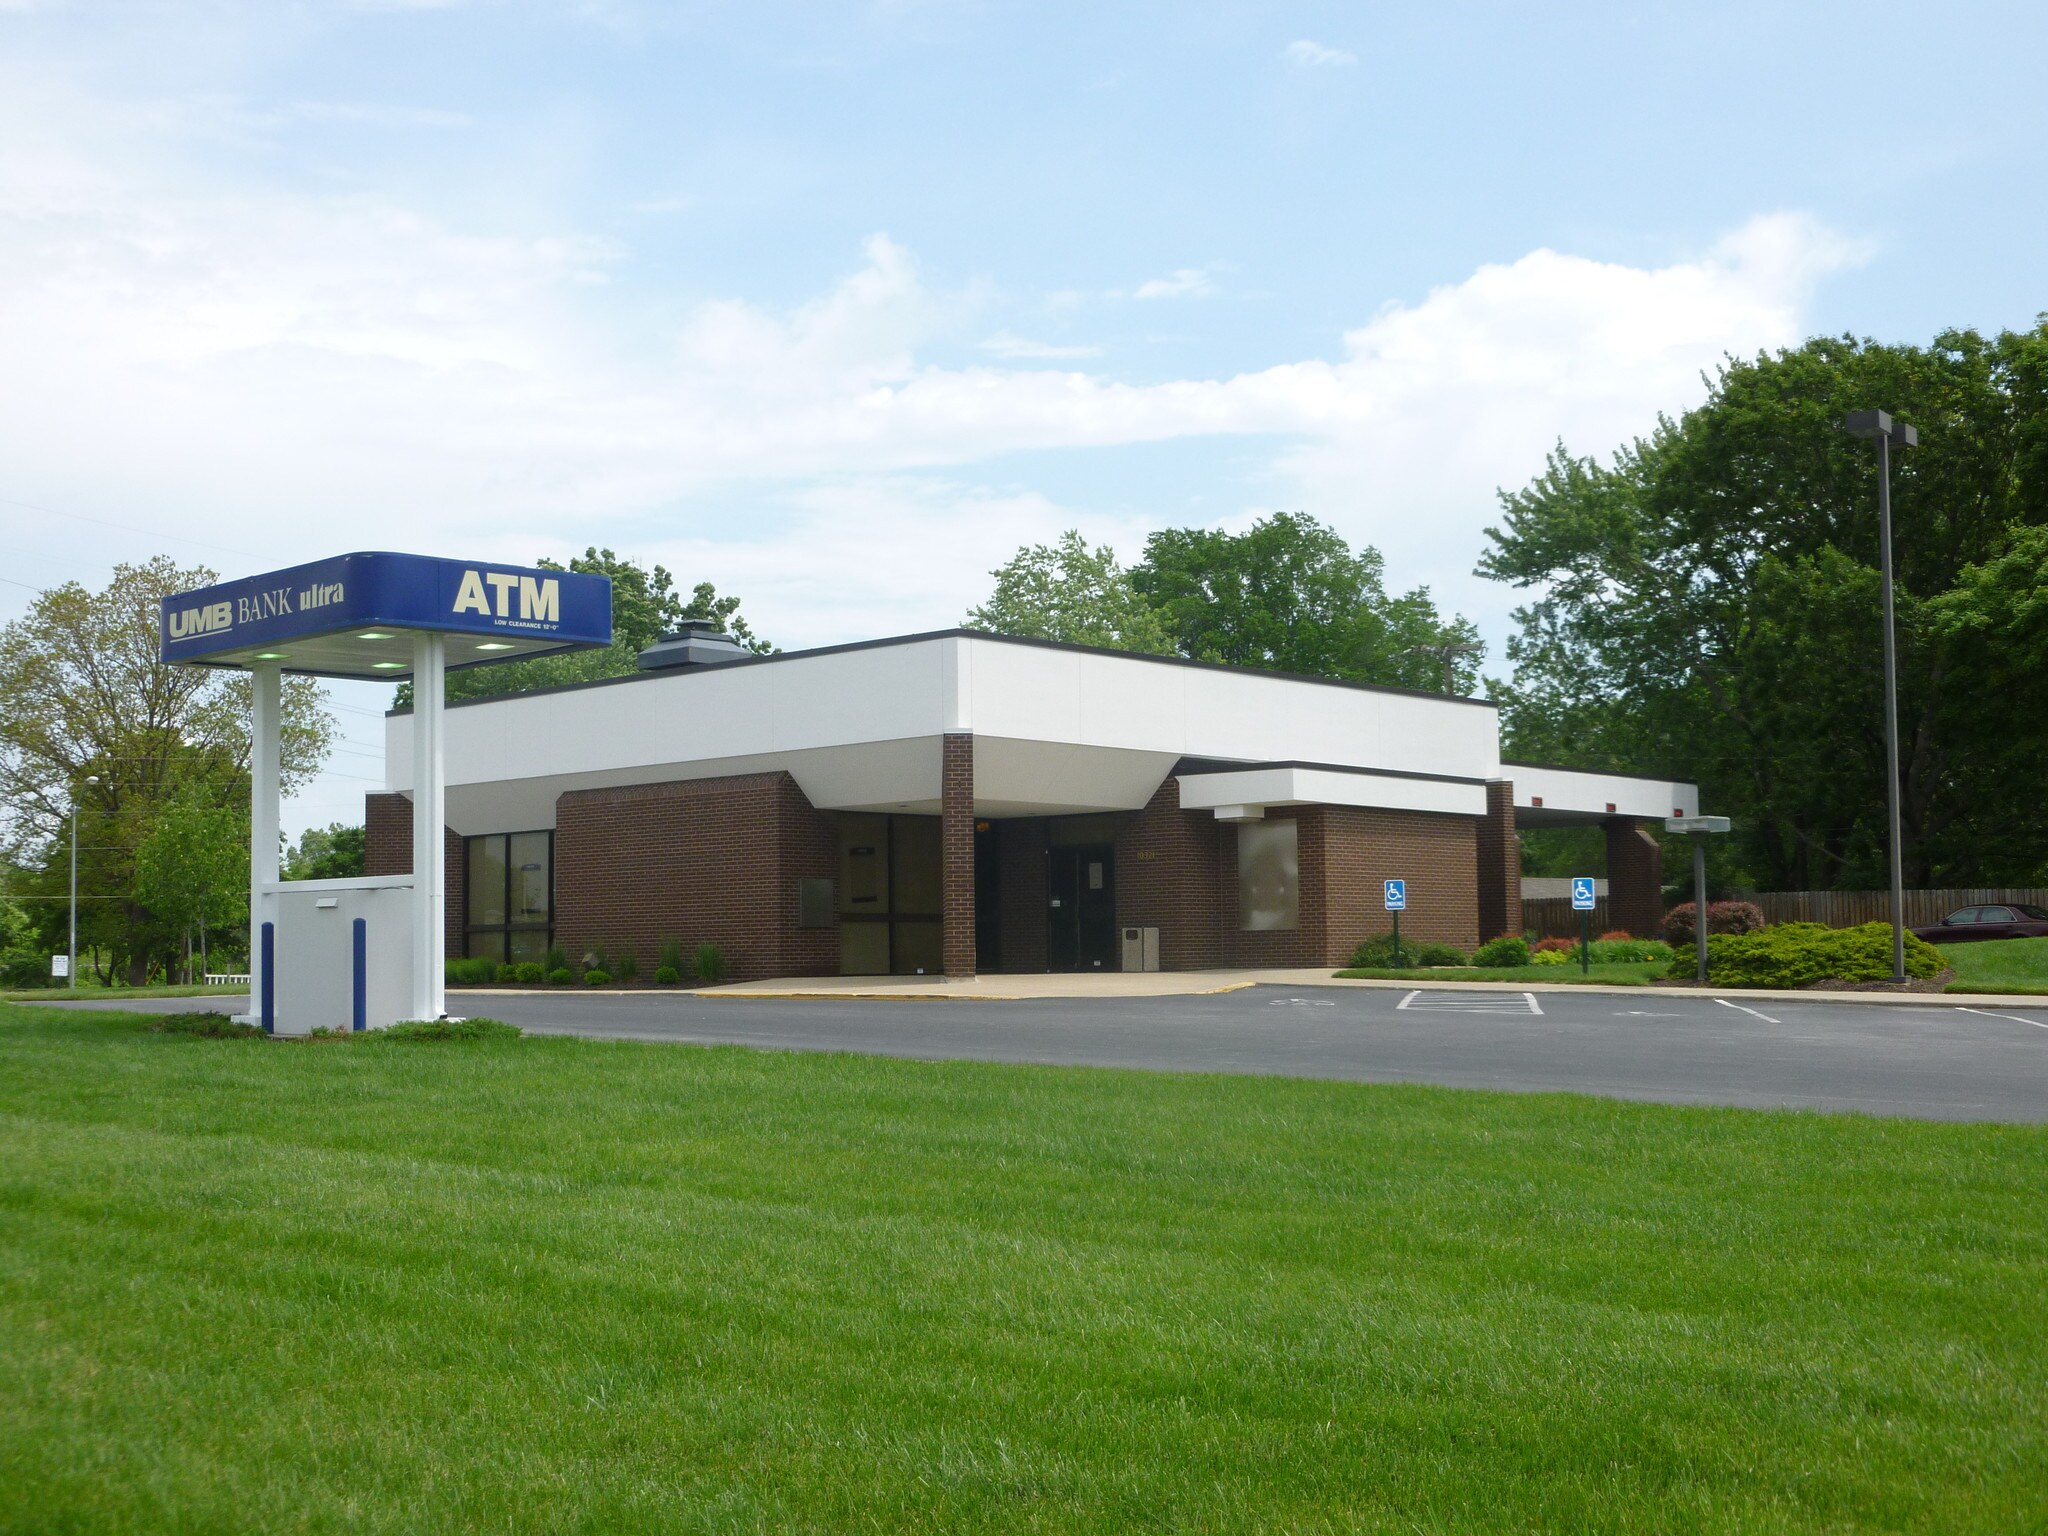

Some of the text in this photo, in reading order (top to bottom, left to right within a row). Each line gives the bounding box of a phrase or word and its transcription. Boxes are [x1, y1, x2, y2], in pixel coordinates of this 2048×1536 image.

[169, 582, 344, 638] UMB BANK ultra
[453, 570, 559, 622] ATM
[508, 620, 542, 630] CLEARANCE
